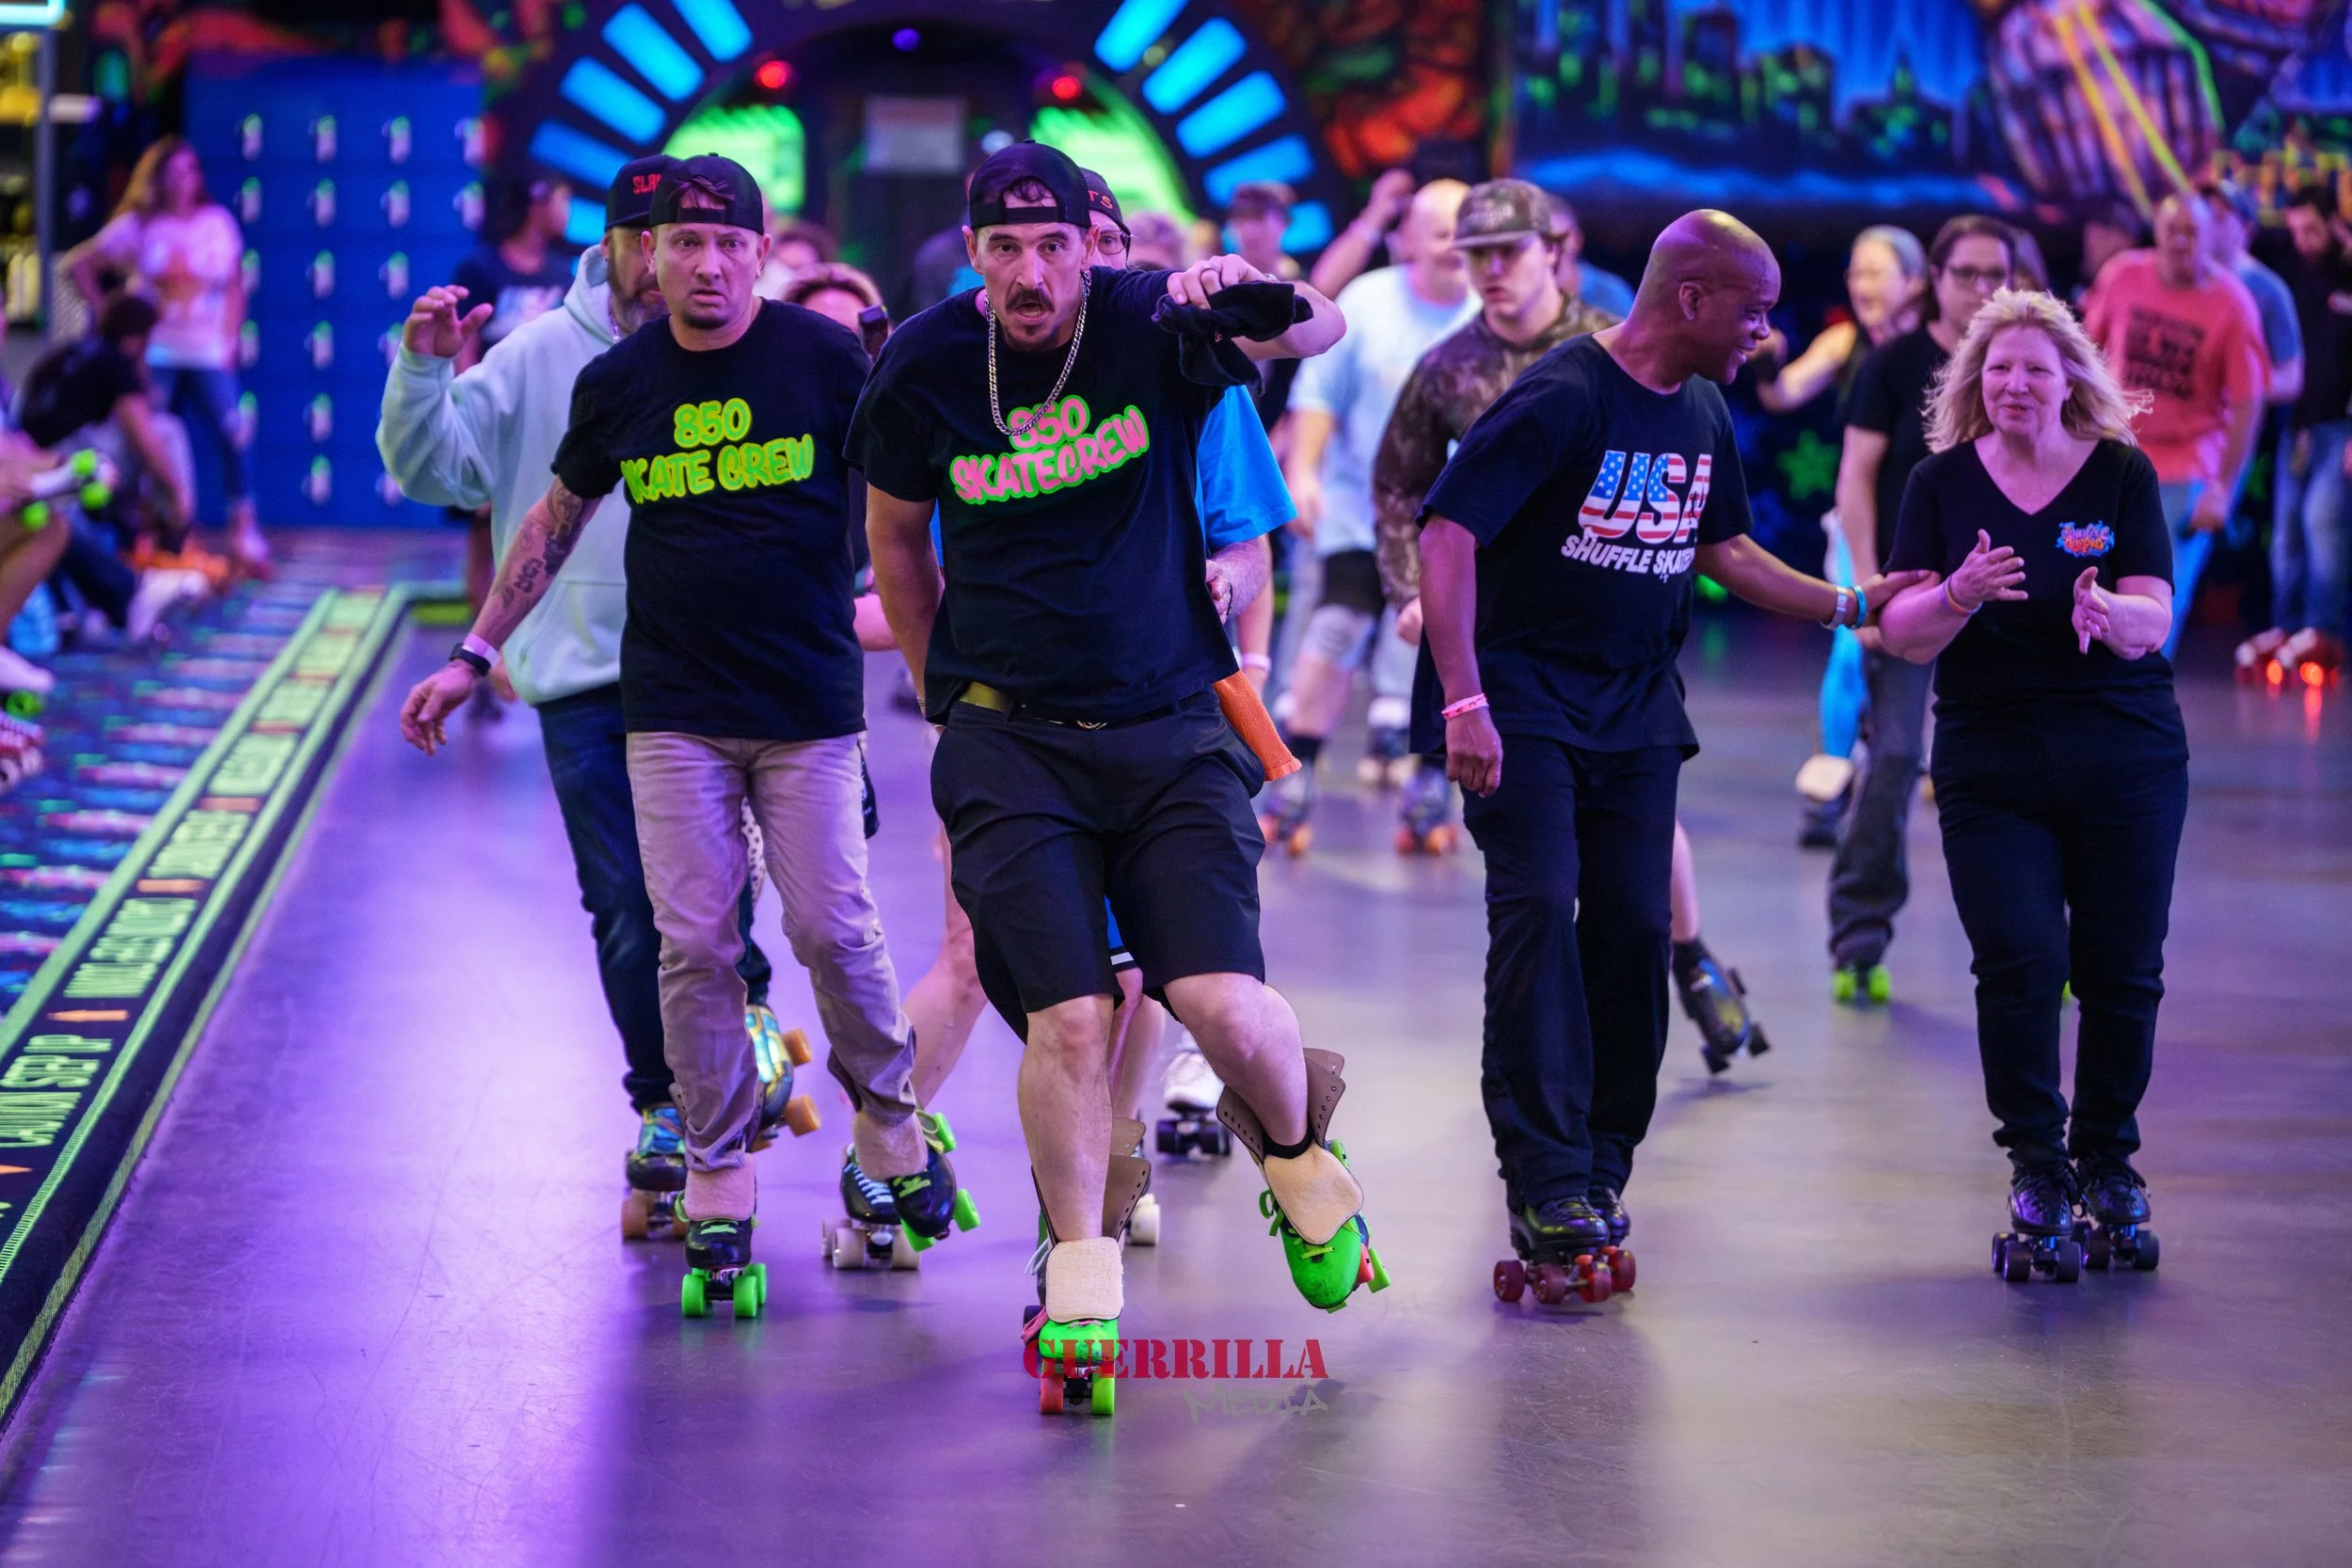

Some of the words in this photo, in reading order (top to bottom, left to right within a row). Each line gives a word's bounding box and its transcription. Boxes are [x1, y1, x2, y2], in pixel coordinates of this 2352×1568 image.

[1088, 190, 1113, 210] TS
[674, 397, 752, 449] 850
[1007, 394, 1090, 451] 850
[717, 433, 815, 491] CREW
[949, 404, 1150, 505] SKATECREW
[1578, 450, 1712, 545] USA
[1561, 526, 1654, 574] SHUFFLE
